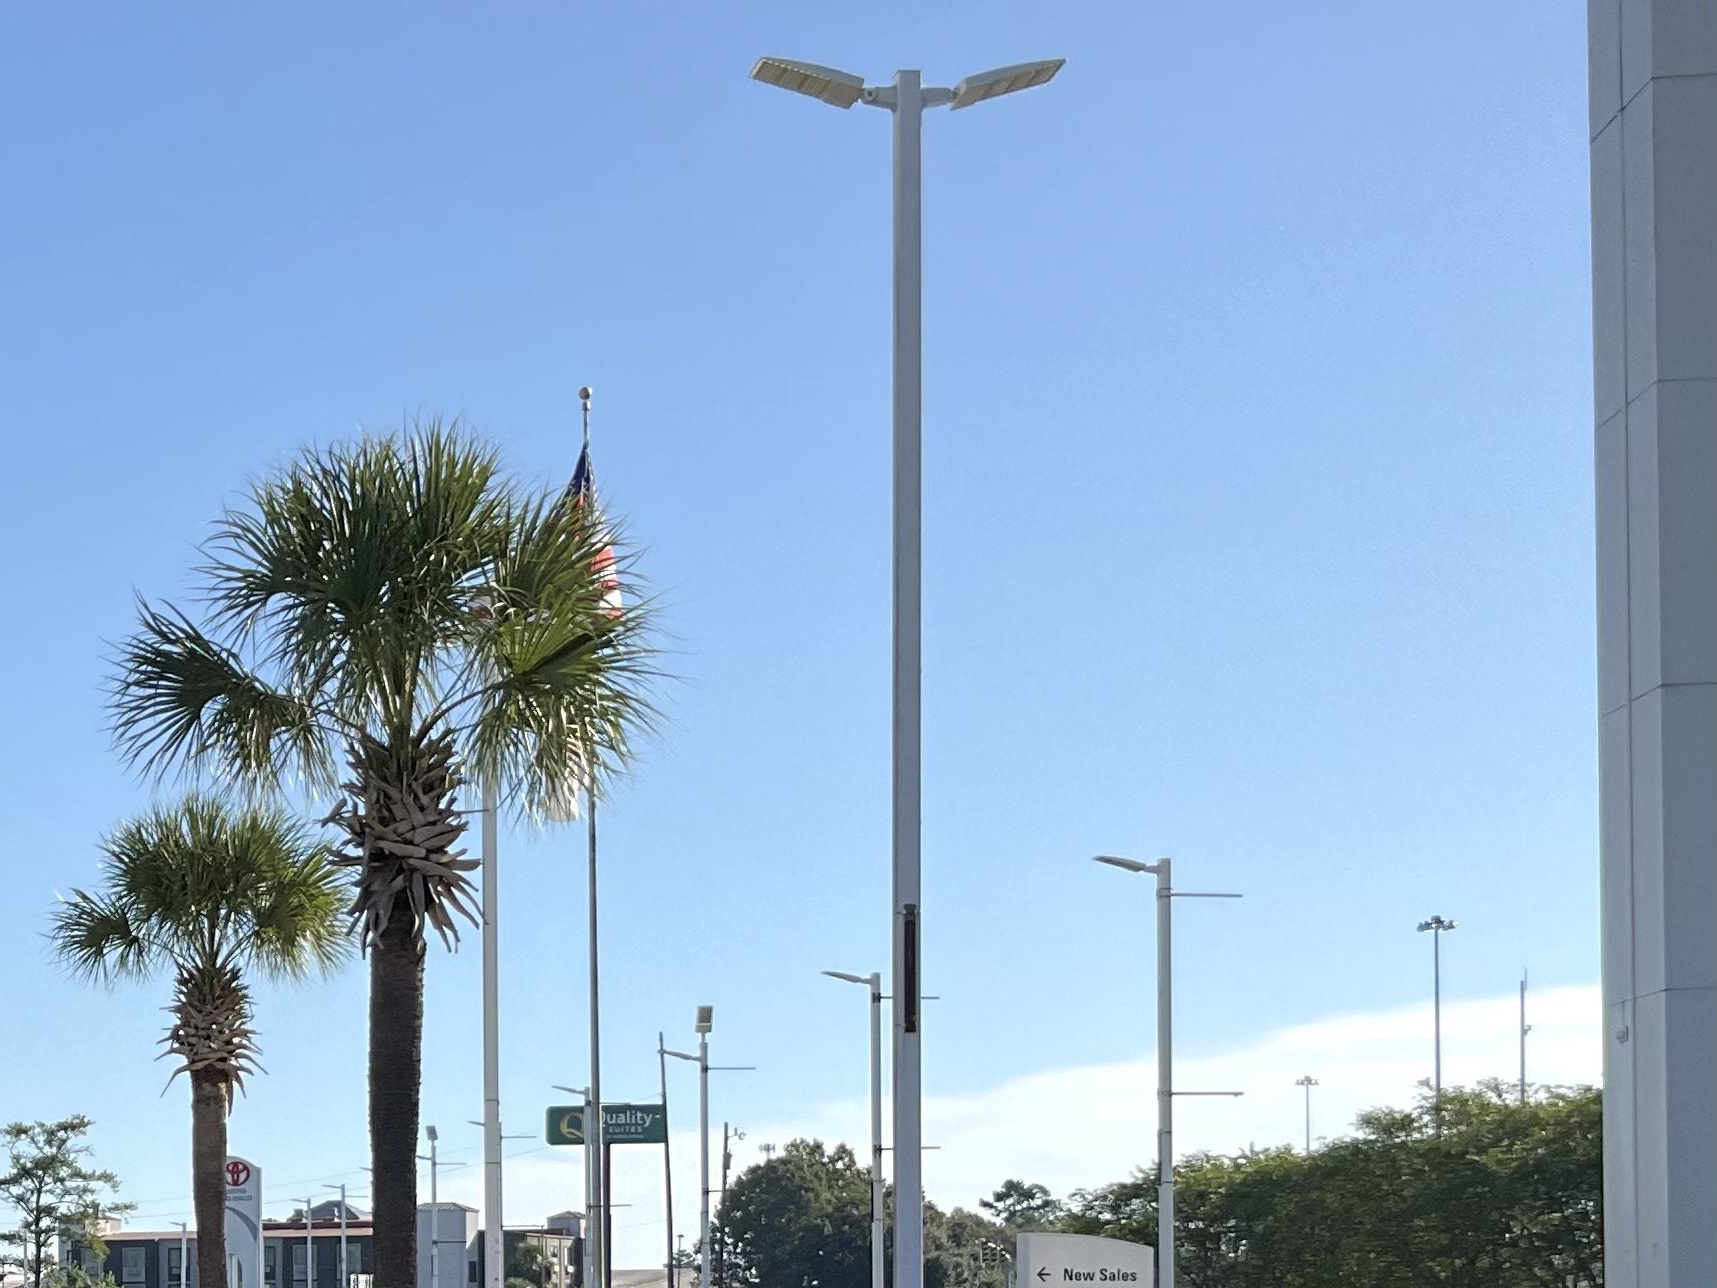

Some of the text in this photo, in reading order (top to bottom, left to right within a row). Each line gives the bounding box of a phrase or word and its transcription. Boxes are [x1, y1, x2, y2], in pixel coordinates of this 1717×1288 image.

[608, 1125, 643, 1133] SUITES
[1063, 1267, 1137, 1281] New Sales
